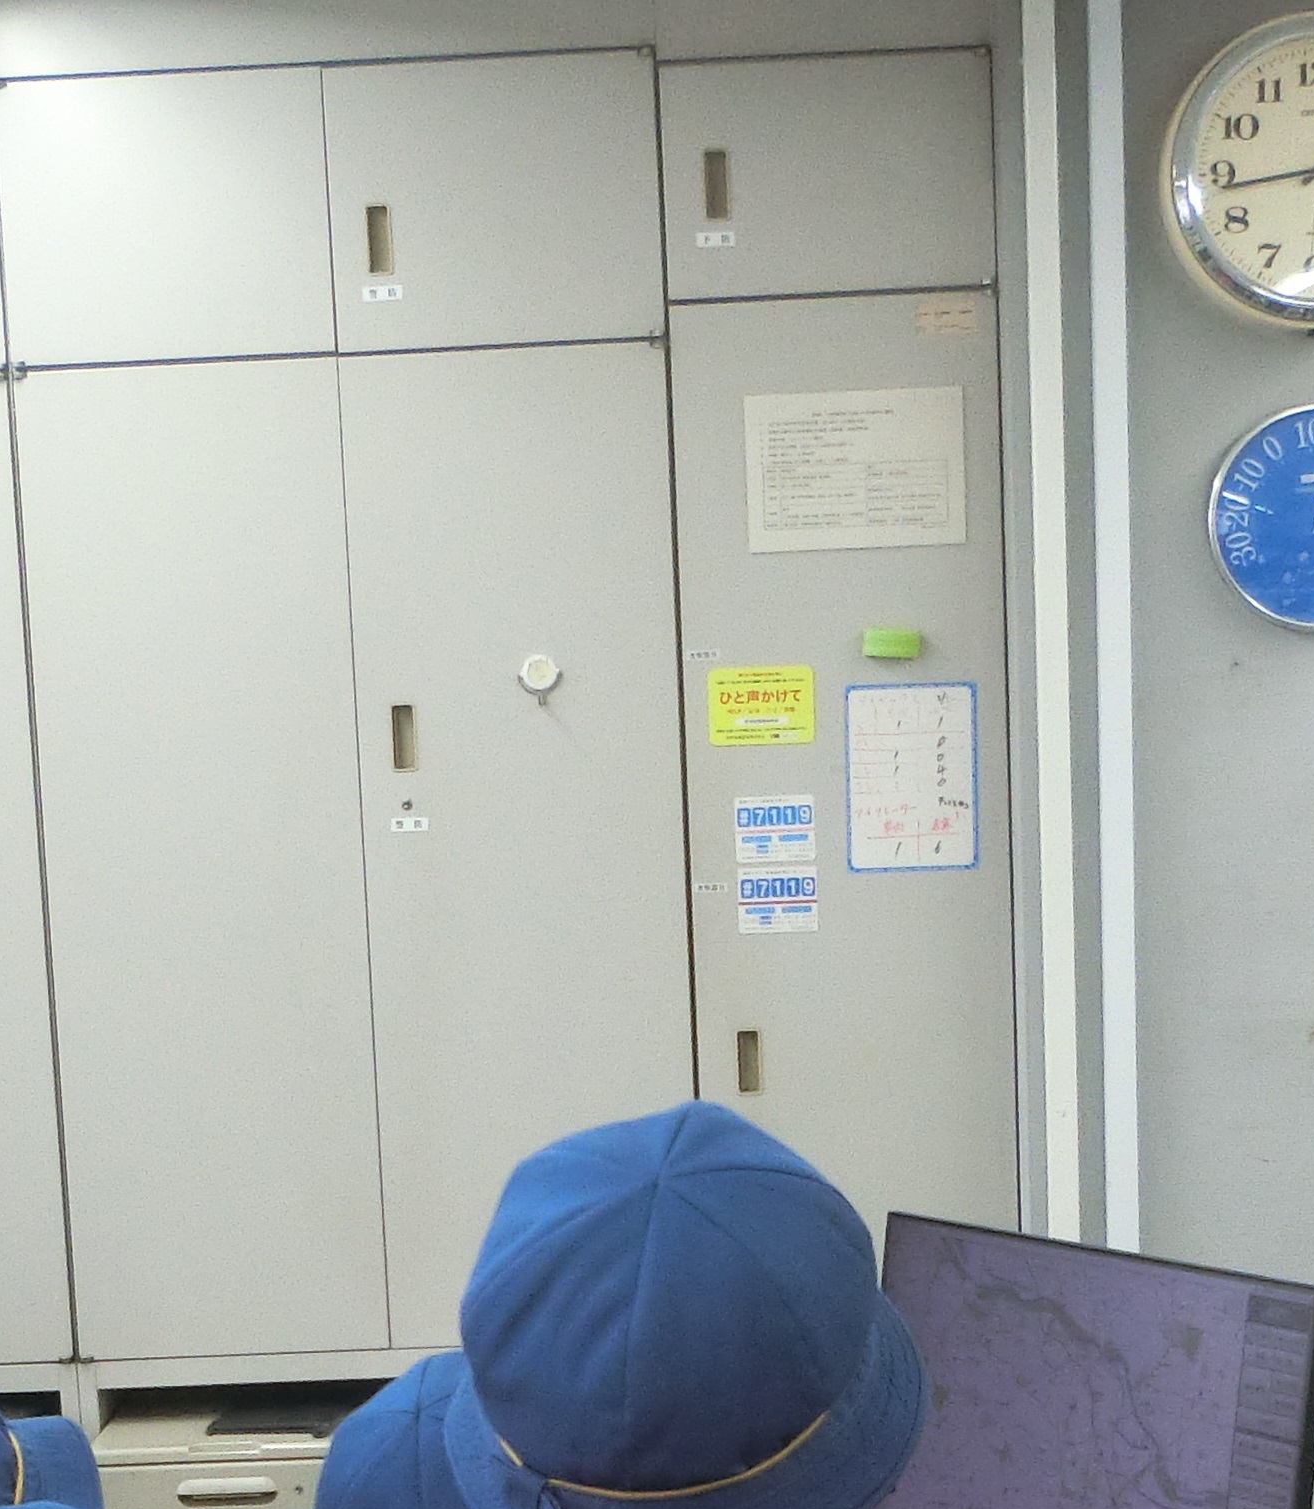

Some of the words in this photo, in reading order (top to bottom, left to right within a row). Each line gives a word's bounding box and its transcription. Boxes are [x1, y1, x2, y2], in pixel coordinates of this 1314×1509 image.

[1255, 78, 1282, 104] 11
[1221, 114, 1260, 141] 10
[1210, 160, 1236, 187] 9
[1224, 206, 1249, 234] 8
[1257, 243, 1282, 269] 7
[1262, 436, 1283, 461] 0
[720, 688, 802, 705] ひと声かけて
[738, 805, 812, 827] #7119
[741, 878, 816, 899] #7119
